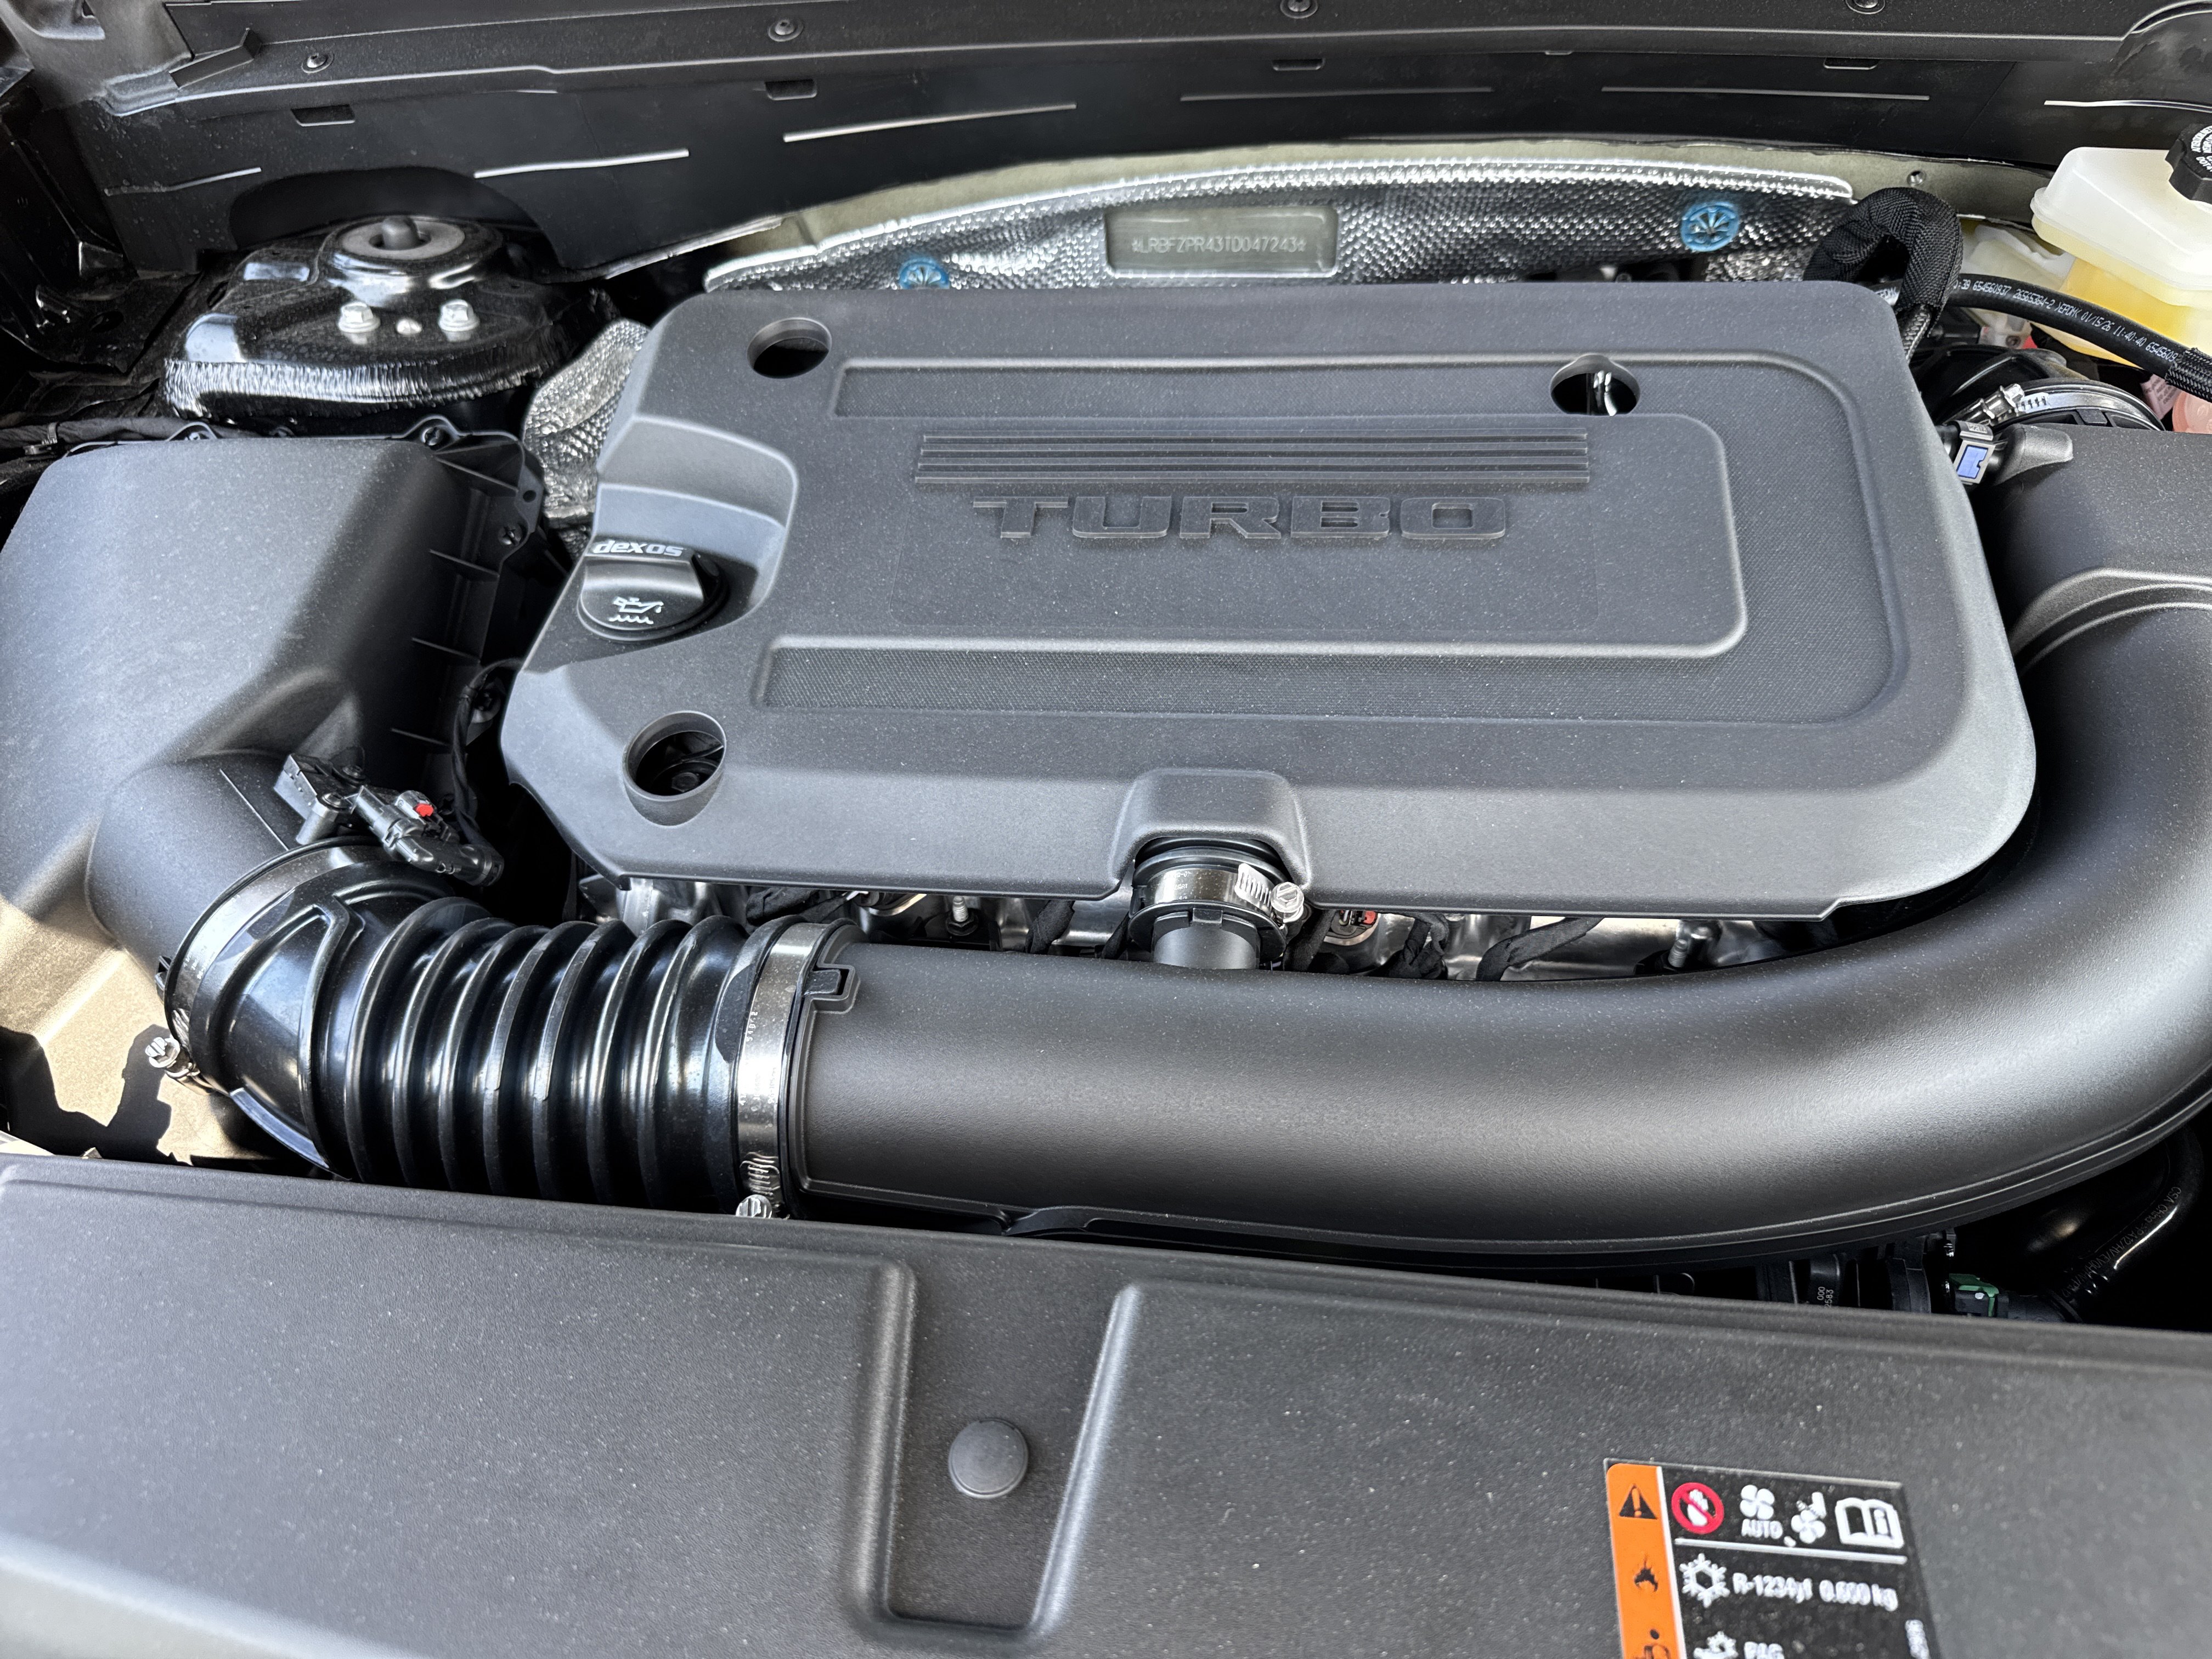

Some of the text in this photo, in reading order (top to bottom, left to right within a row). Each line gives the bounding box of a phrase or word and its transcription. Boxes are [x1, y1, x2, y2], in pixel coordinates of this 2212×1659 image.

[2081, 312, 2114, 331] 01/15/26
[2113, 325, 2147, 347] 11:40:40
[973, 495, 1506, 540] TURBO
[592, 539, 685, 557] dexos
[1741, 1519, 1783, 1539] AUTO
